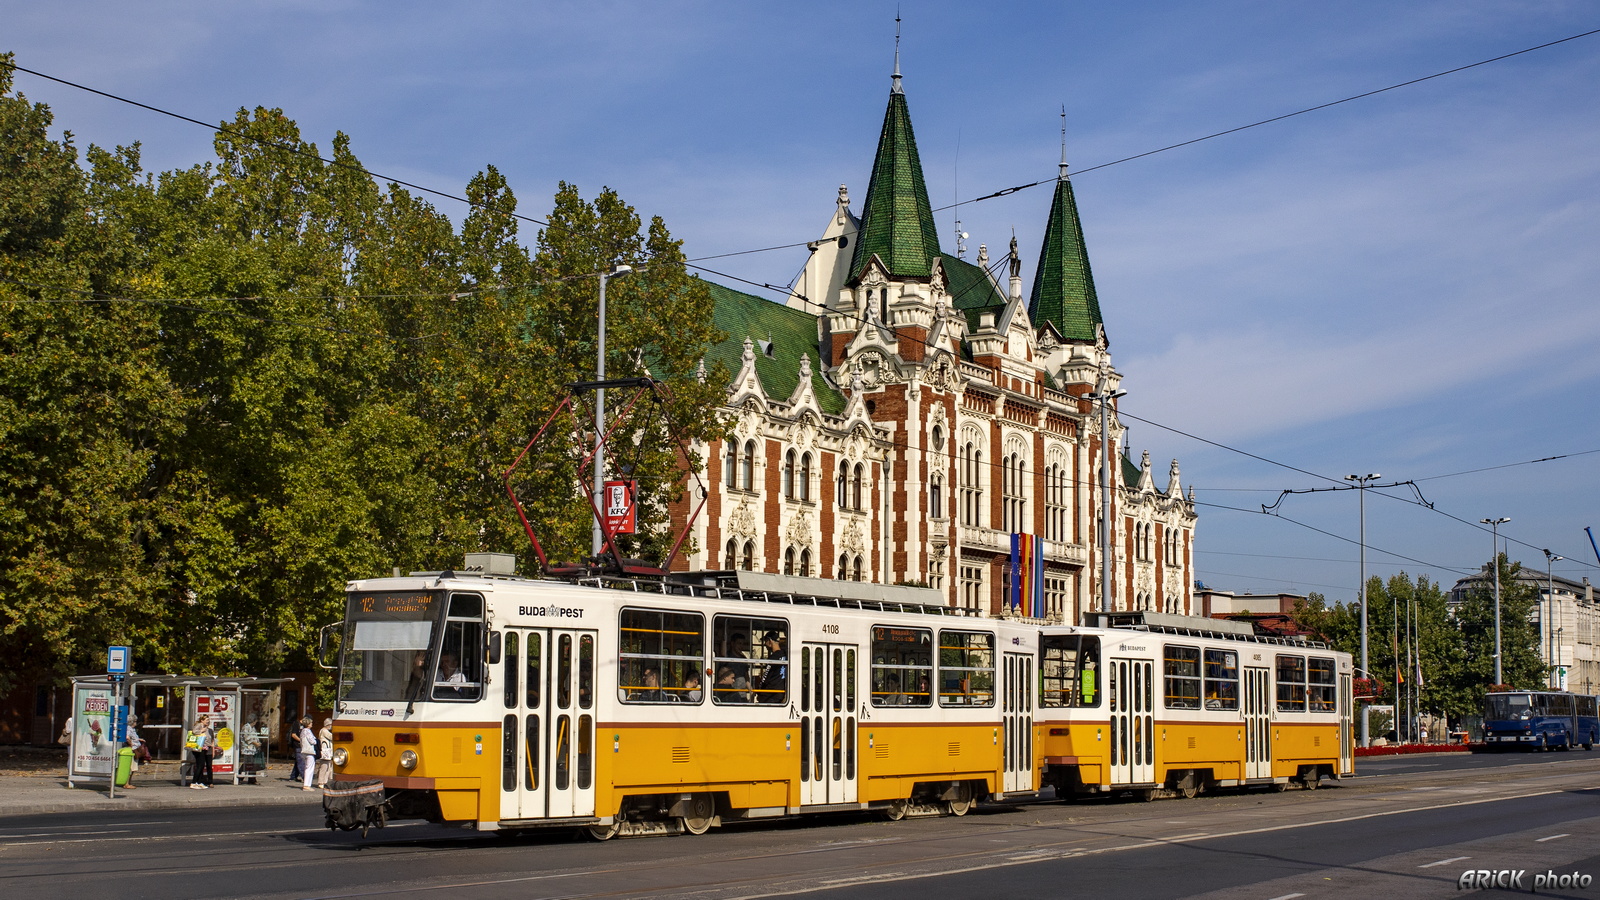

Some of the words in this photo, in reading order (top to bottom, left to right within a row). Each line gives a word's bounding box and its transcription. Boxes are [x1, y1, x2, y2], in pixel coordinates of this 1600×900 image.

[610, 508, 628, 516] KFC
[822, 624, 839, 635] 4108
[876, 627, 885, 640] 12
[86, 702, 108, 711] KEDDEN
[213, 697, 228, 713] 25
[361, 745, 387, 758] 4108
